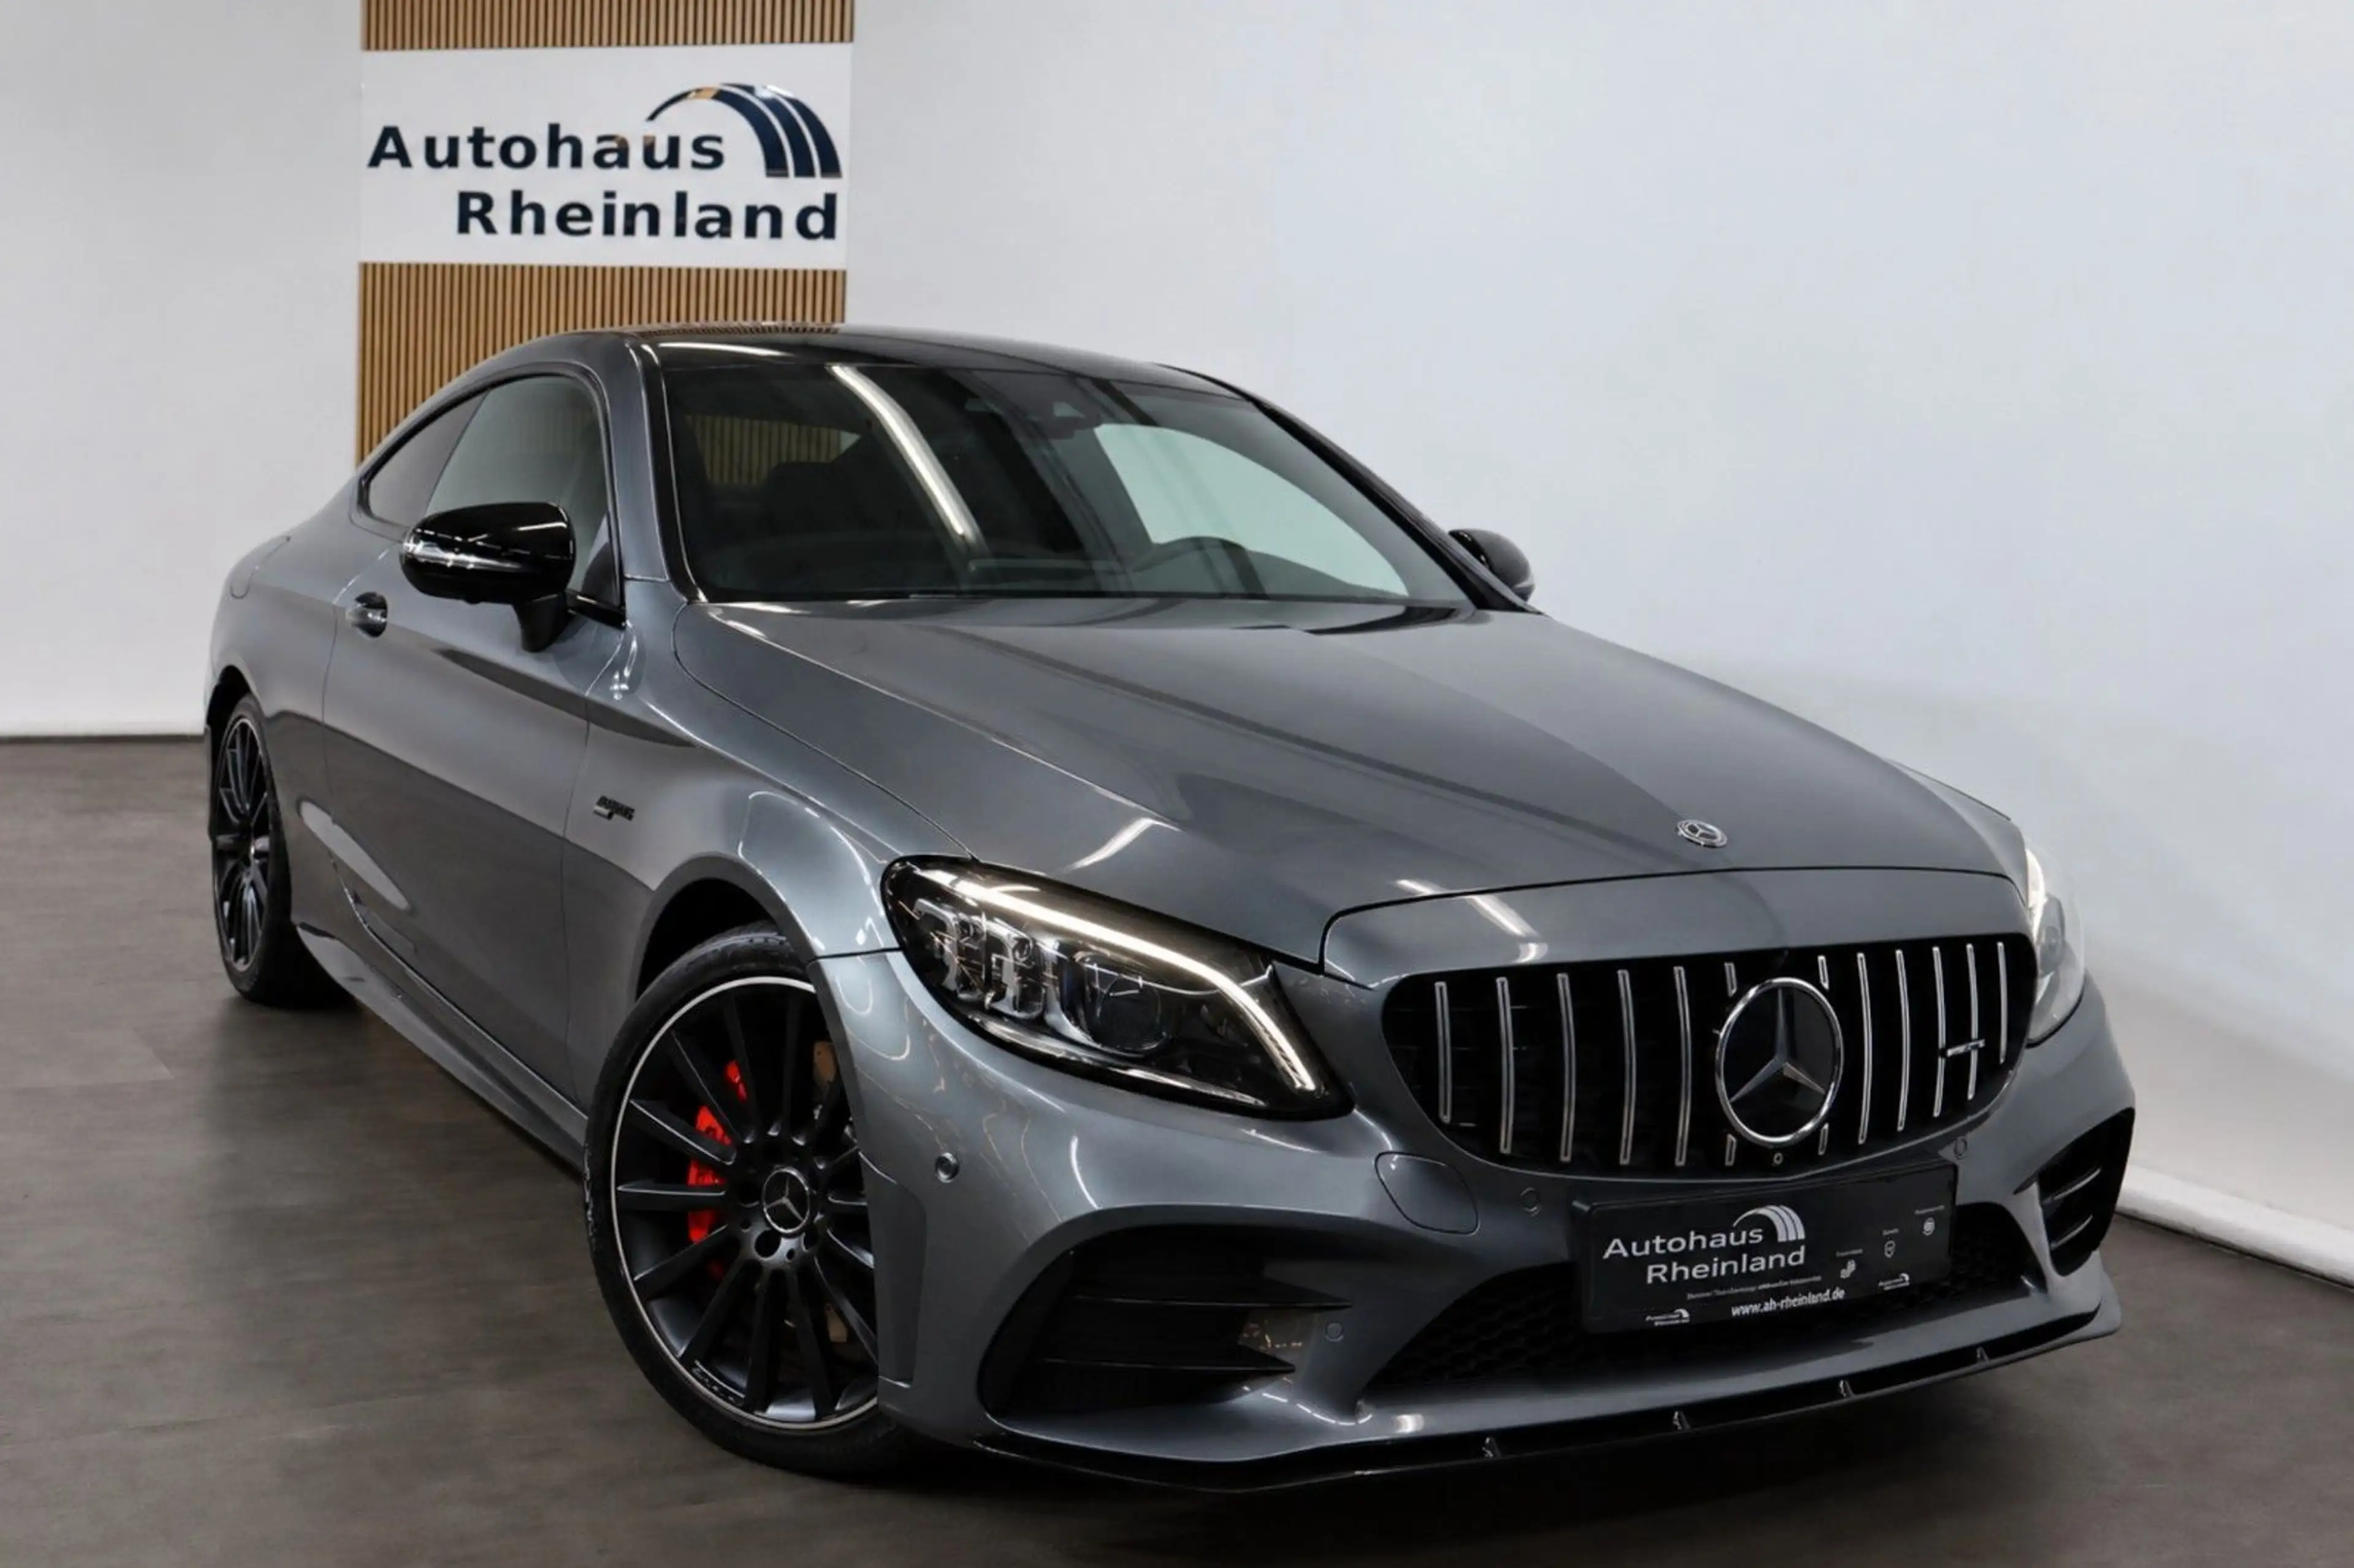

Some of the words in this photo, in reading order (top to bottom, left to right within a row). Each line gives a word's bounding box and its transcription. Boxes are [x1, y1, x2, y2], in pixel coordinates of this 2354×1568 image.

[367, 123, 725, 170] Autohaus
[457, 190, 837, 240] Rheinland
[1602, 1228, 1763, 1260] Autohaus
[1647, 1245, 1805, 1284] Rheinland
[1731, 1286, 1846, 1317] www.ah-rheinland.de
